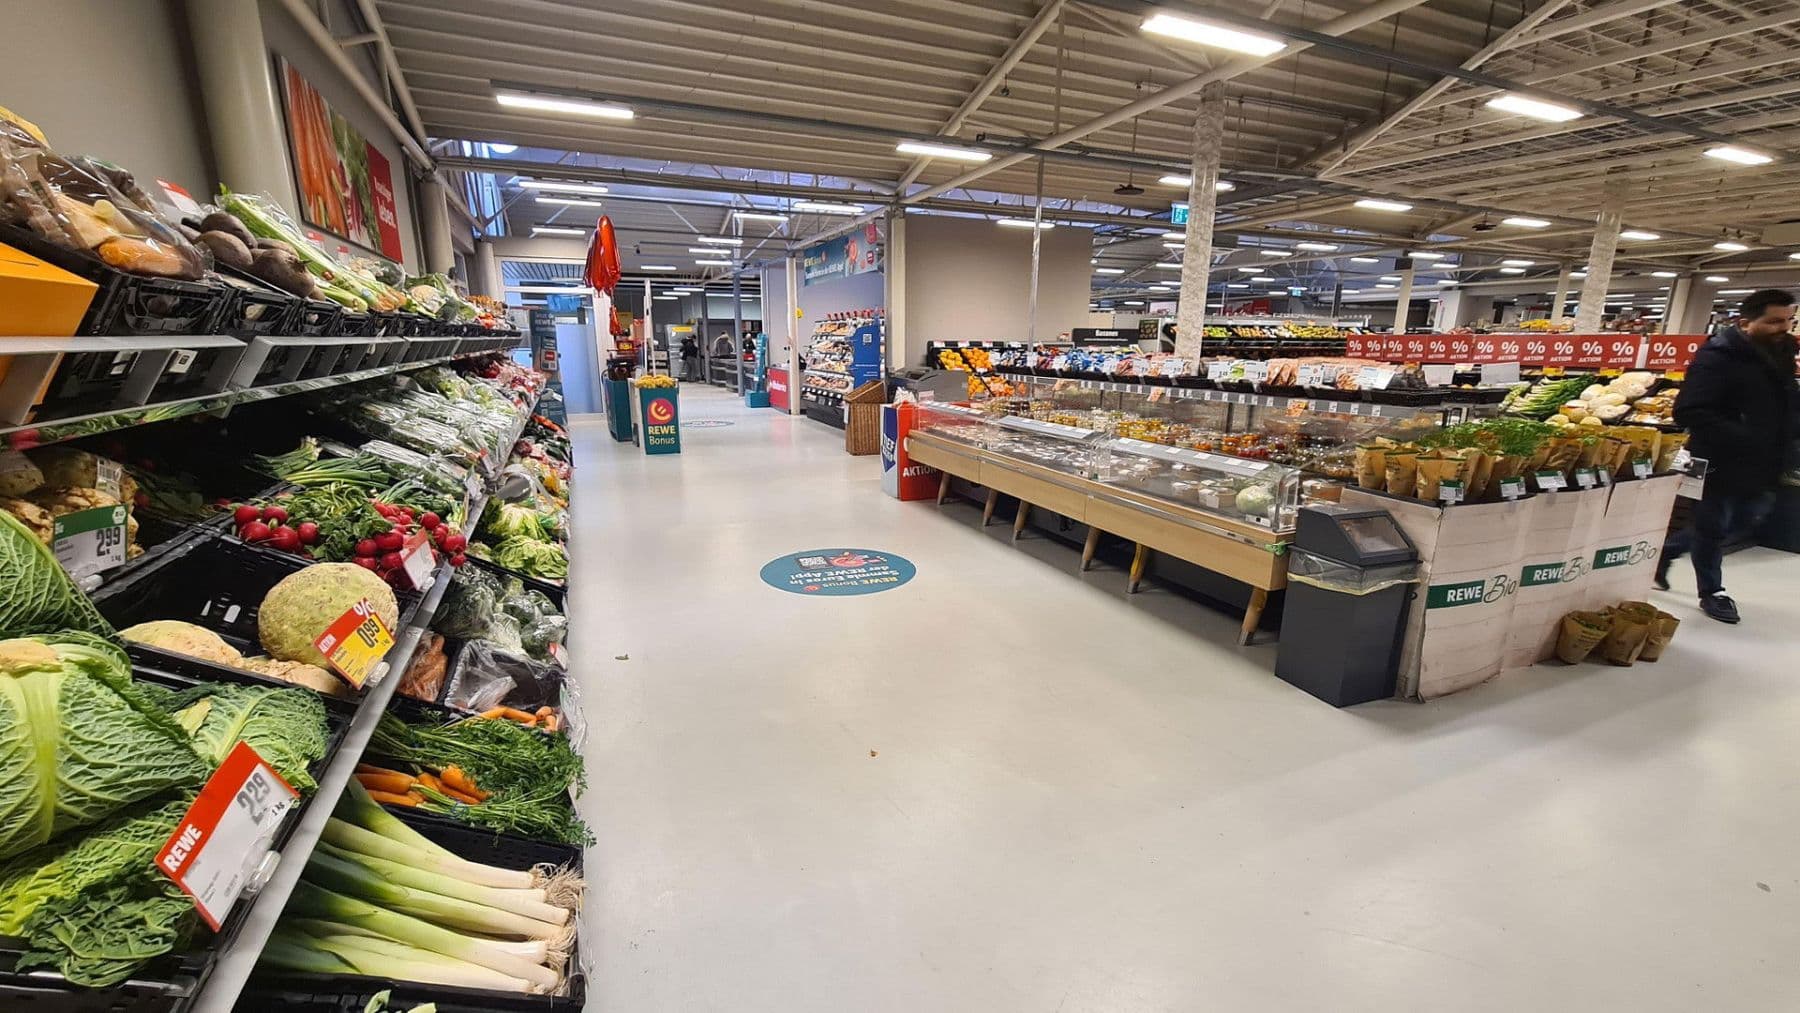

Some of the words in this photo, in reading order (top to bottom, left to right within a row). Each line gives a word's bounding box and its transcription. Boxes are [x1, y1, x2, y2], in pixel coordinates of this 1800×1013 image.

[648, 425, 676, 435] REWE
[649, 436, 675, 445] Bonus
[903, 465, 937, 478] AKTION
[1604, 550, 1630, 564] REWE
[1628, 541, 1658, 566] Bio
[825, 567, 867, 577] REWE
[847, 570, 900, 580] Sammle
[1533, 567, 1564, 581] REWE
[1562, 557, 1591, 583] Bio
[806, 575, 845, 583] Euros
[823, 580, 859, 588] Bonus
[862, 577, 898, 585] REWE
[1446, 585, 1482, 602] REWE
[1483, 574, 1518, 604] Bio
[163, 823, 202, 873] REWE
